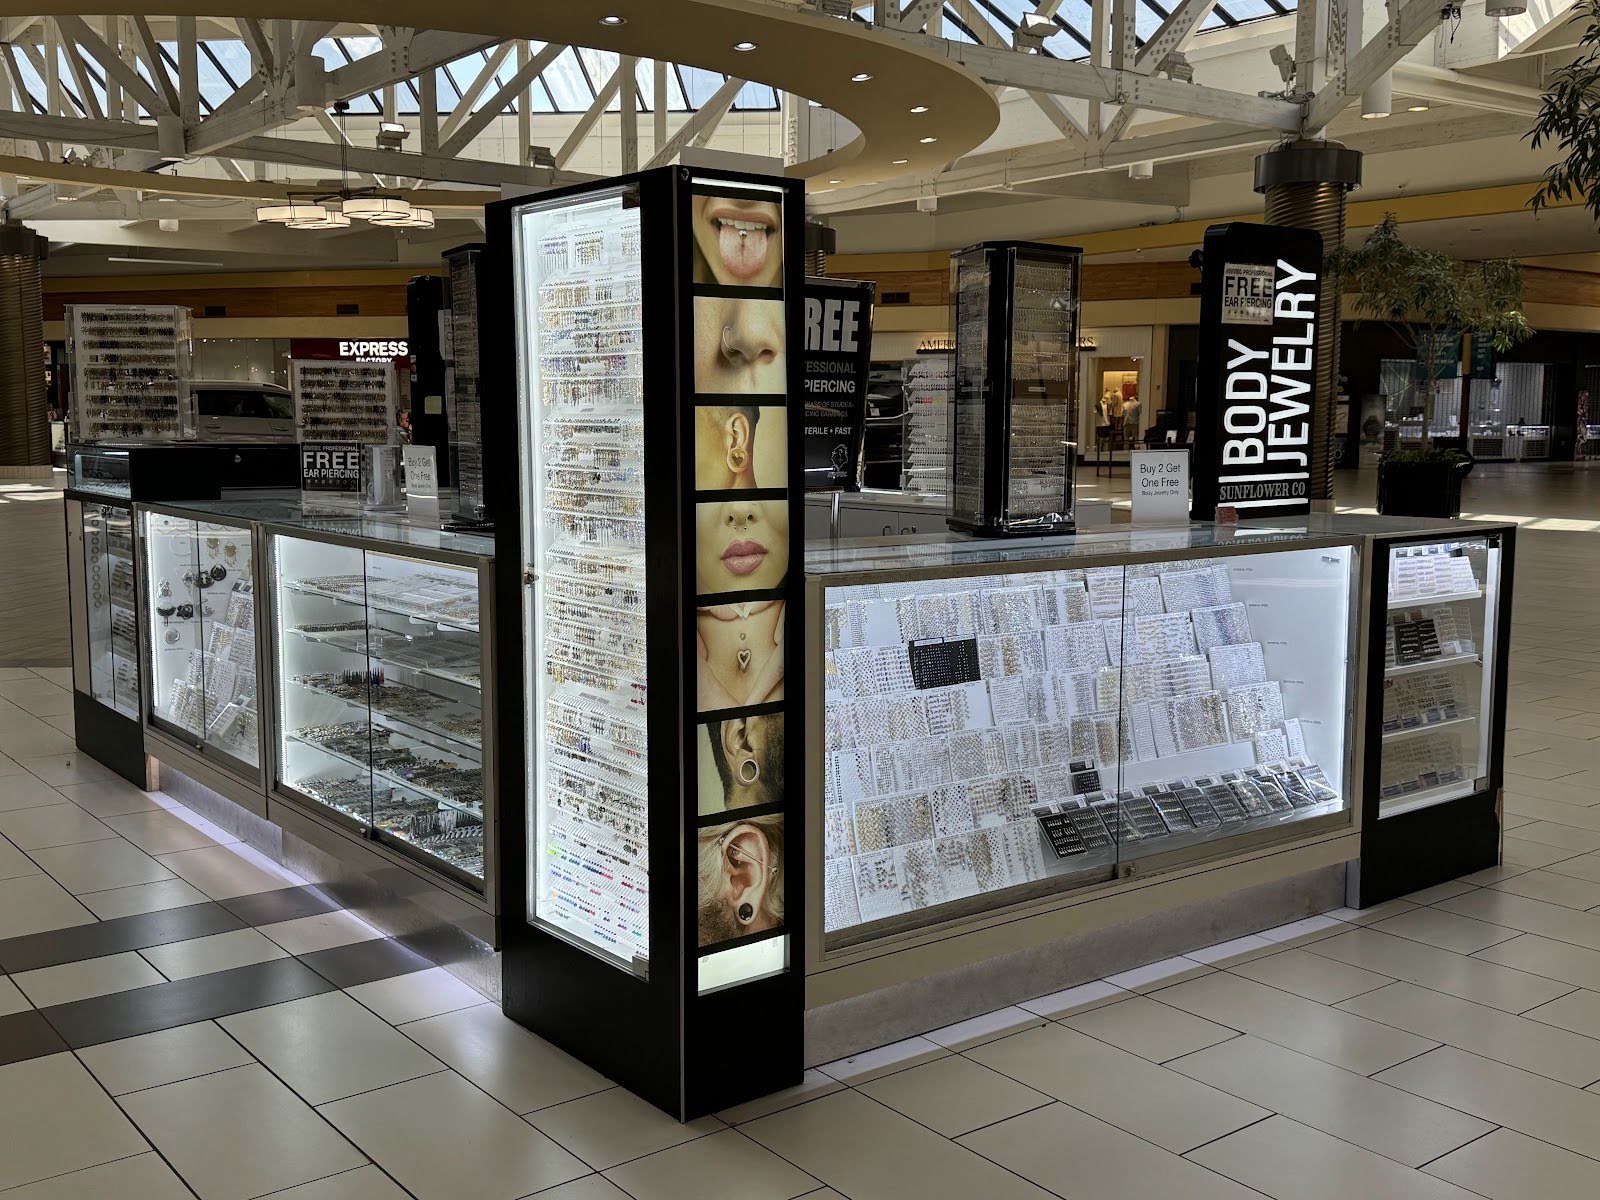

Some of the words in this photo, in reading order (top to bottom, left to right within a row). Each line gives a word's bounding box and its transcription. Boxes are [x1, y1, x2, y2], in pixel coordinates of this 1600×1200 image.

[1225, 276, 1273, 297] FREE
[1225, 297, 1239, 307] EAR
[1240, 297, 1272, 308] PIERCING
[804, 297, 860, 353] REE
[339, 341, 409, 357] EXPRESS
[804, 360, 857, 374] ESSIONAL
[1267, 259, 1317, 467] JEWELRY
[1223, 338, 1270, 466] BODY
[804, 426, 828, 435] TERILE
[834, 426, 852, 435] FAST
[303, 452, 360, 469] FREE
[303, 469, 320, 478] EAR
[322, 469, 360, 479] PIERCING
[1140, 463, 1156, 475] Buy
[1158, 463, 1163, 473] 2
[1166, 463, 1181, 473] Get
[1141, 478, 1159, 487] One
[1161, 477, 1179, 487] Free
[1219, 482, 1290, 500] SUNFLOWER
[1291, 481, 1306, 496] CO
